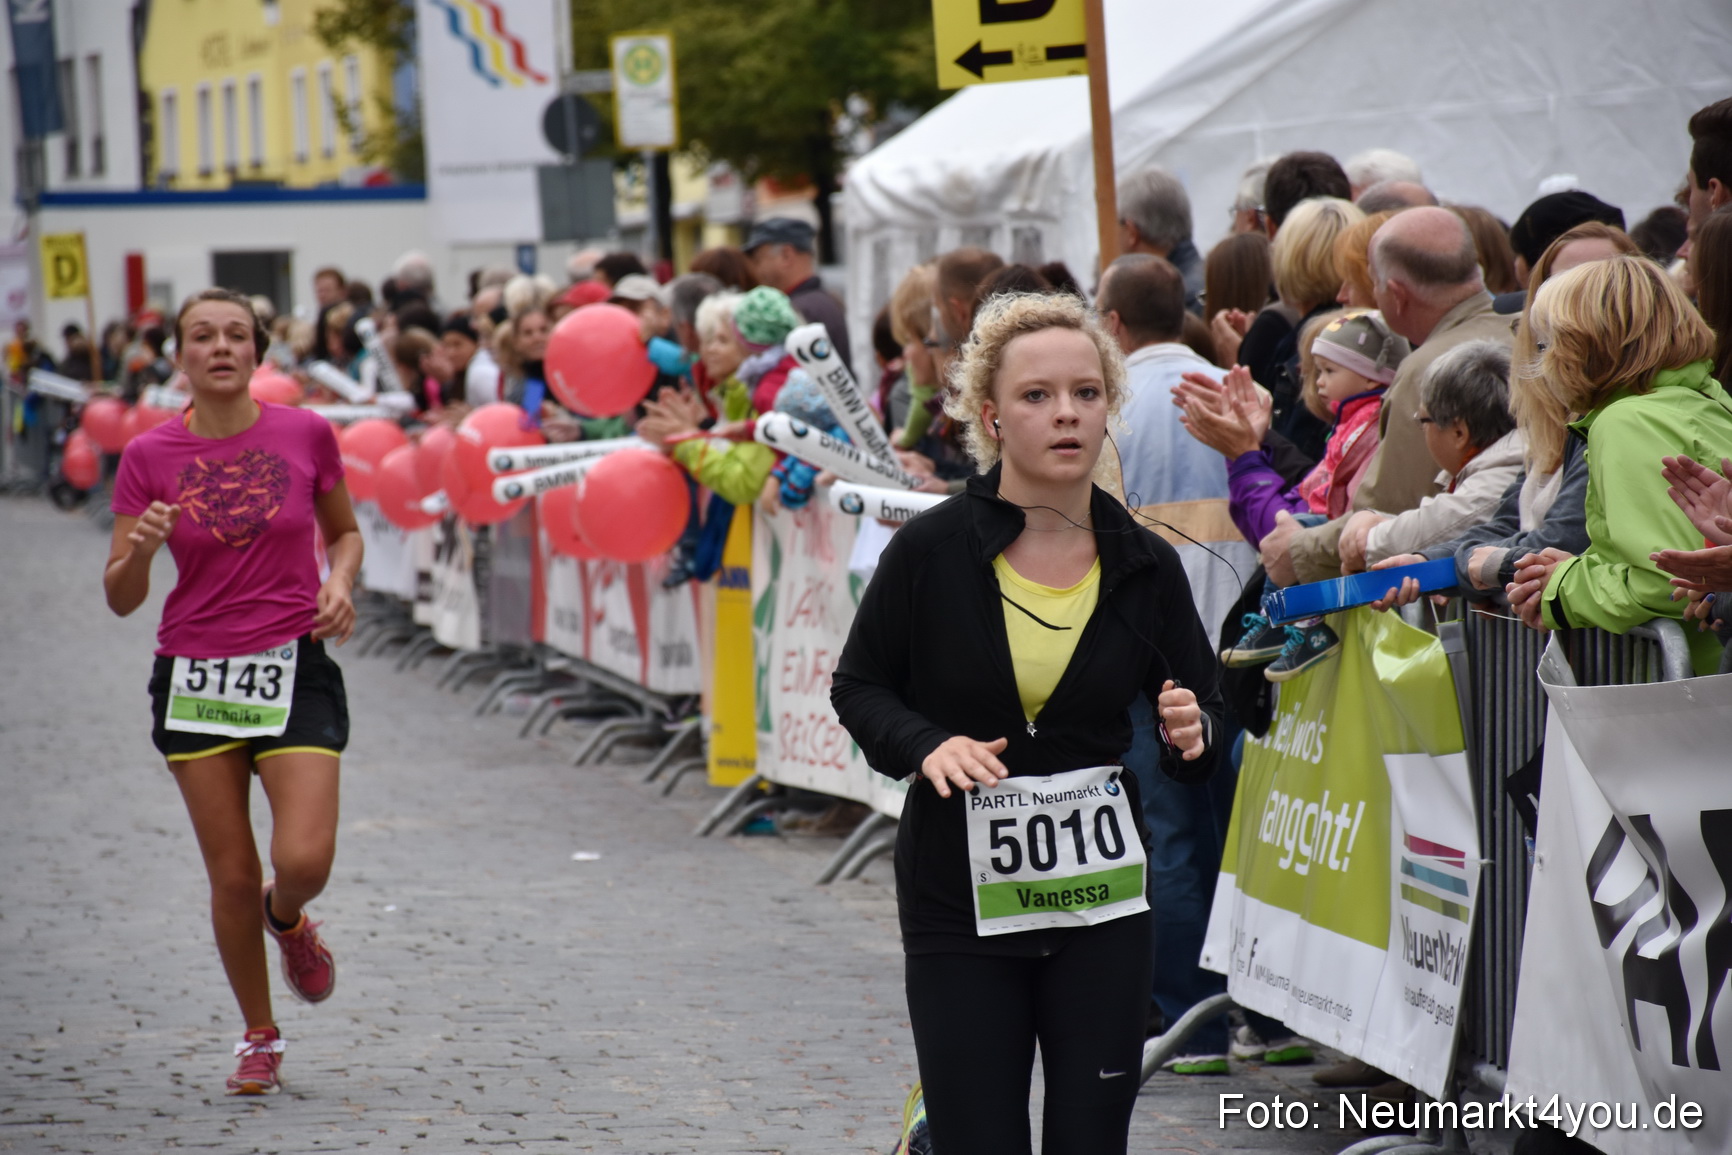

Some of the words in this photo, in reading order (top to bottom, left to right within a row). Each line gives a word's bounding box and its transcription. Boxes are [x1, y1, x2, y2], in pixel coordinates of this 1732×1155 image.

[827, 366, 862, 414] BMW
[186, 659, 283, 701] 5143
[196, 703, 262, 725] Veronika
[971, 793, 1028, 811] PARTL
[1033, 784, 1102, 806] Neumarkt
[989, 804, 1126, 875] 5010
[1258, 772, 1366, 876] langght!
[980, 872, 988, 883] S
[1016, 883, 1110, 908] Vanessa
